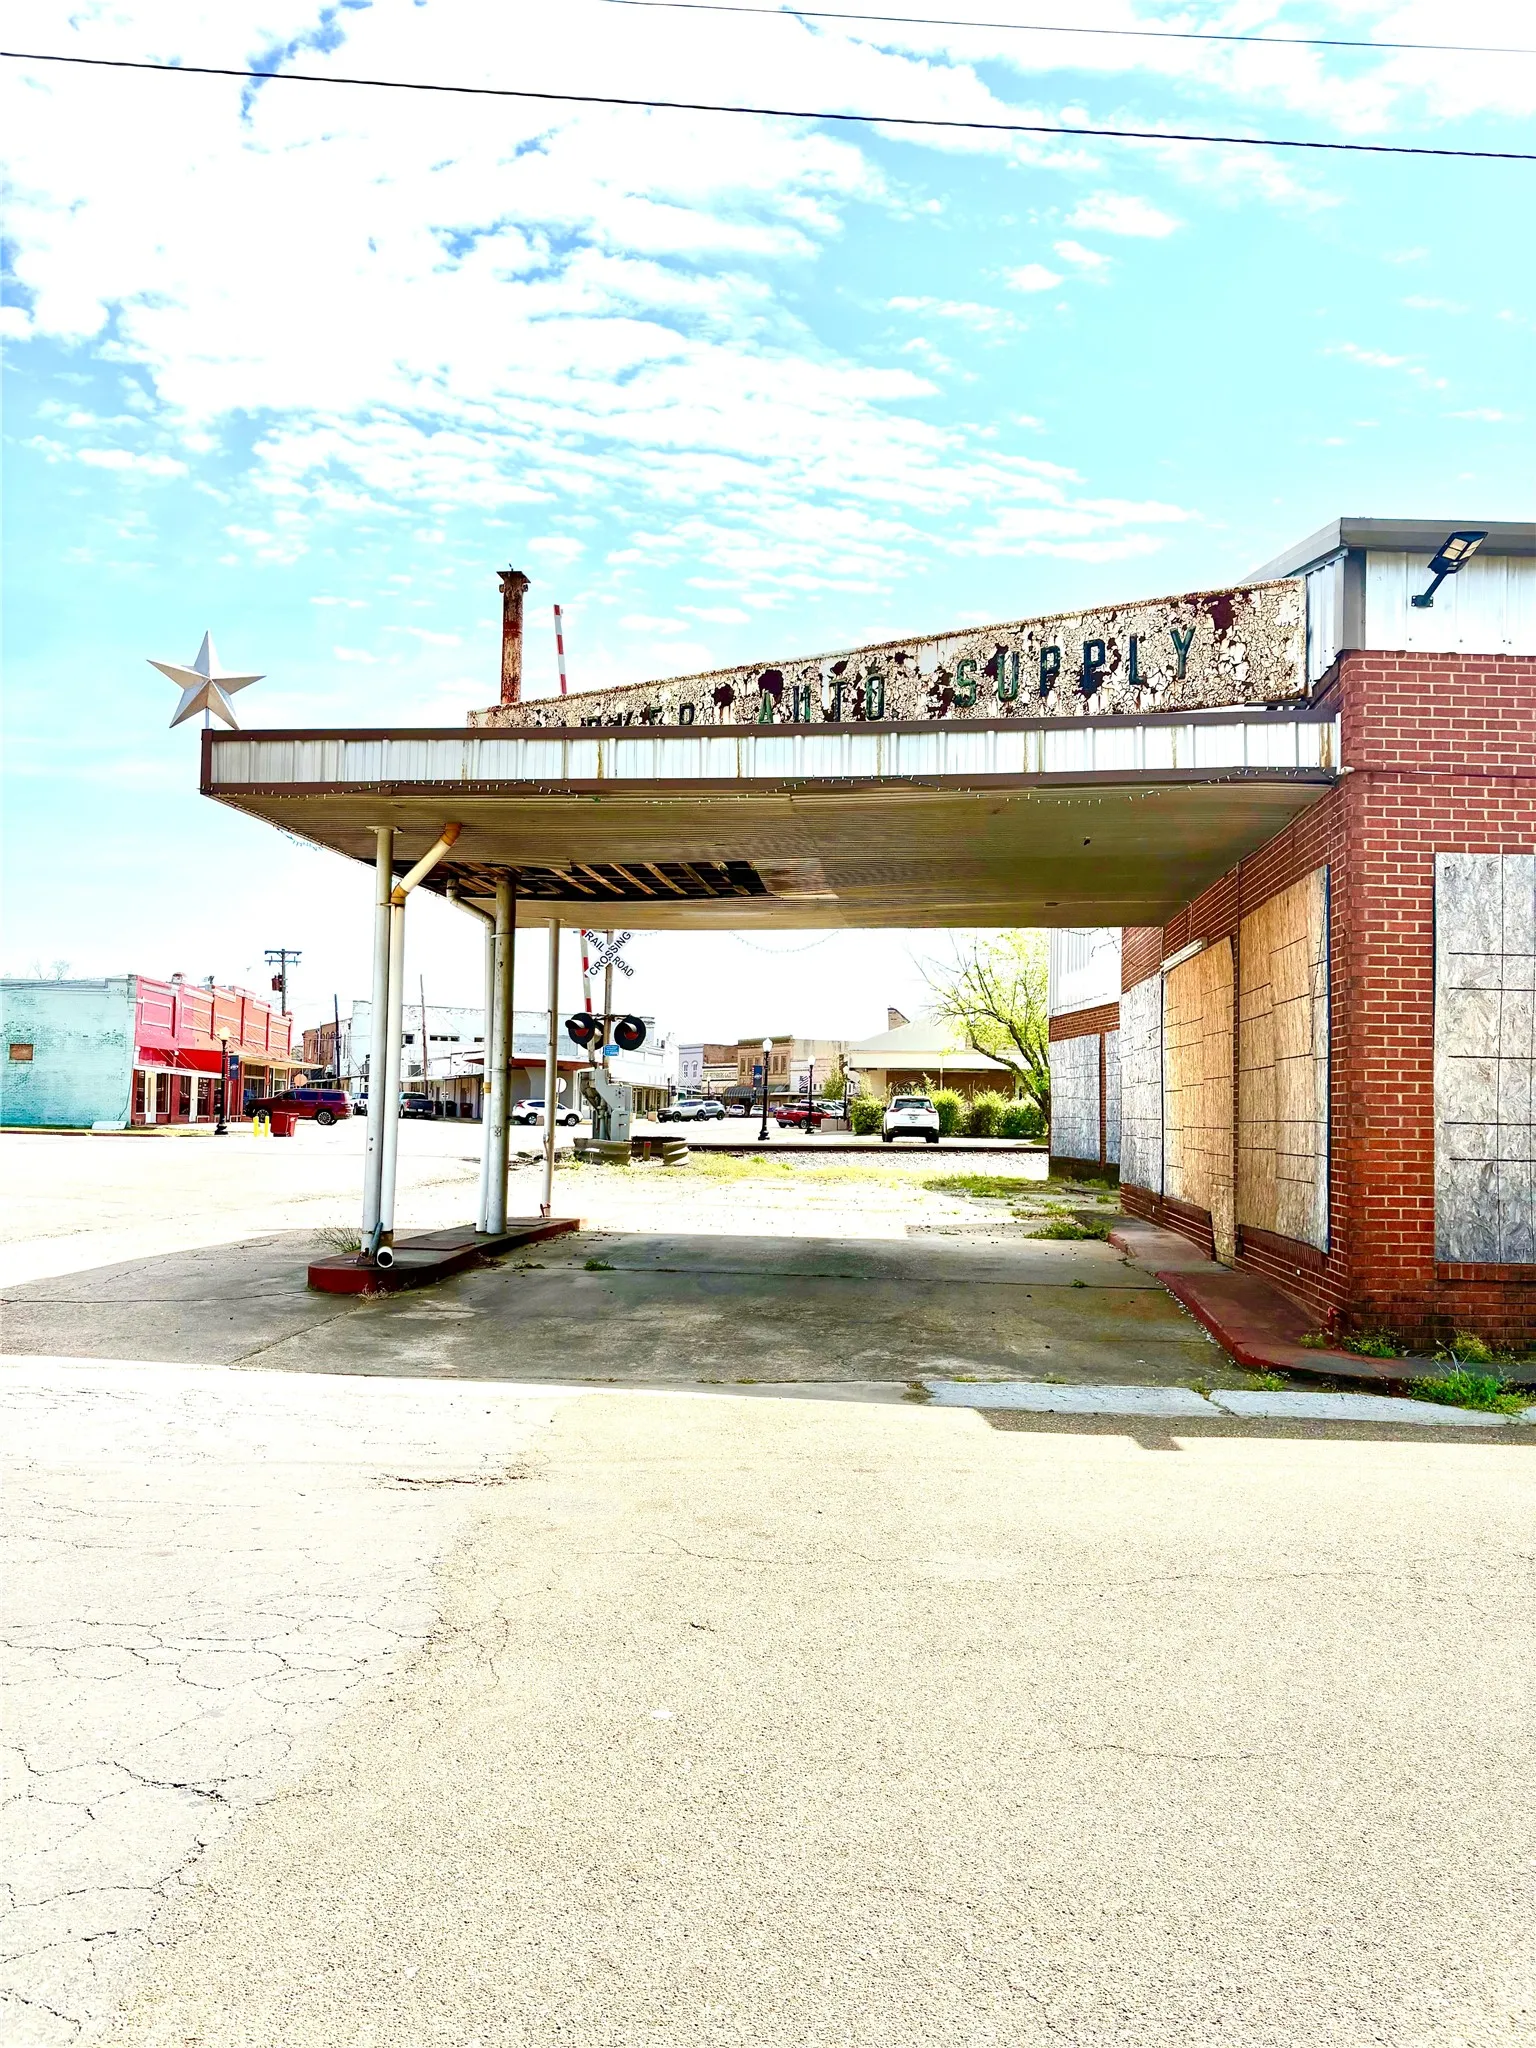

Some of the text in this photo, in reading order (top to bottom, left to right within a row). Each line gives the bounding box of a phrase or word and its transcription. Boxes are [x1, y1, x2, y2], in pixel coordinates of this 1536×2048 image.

[953, 626, 1196, 707] SUPPLY
[585, 931, 634, 977] RAIL ROAD
[589, 931, 632, 976] CROSSING
